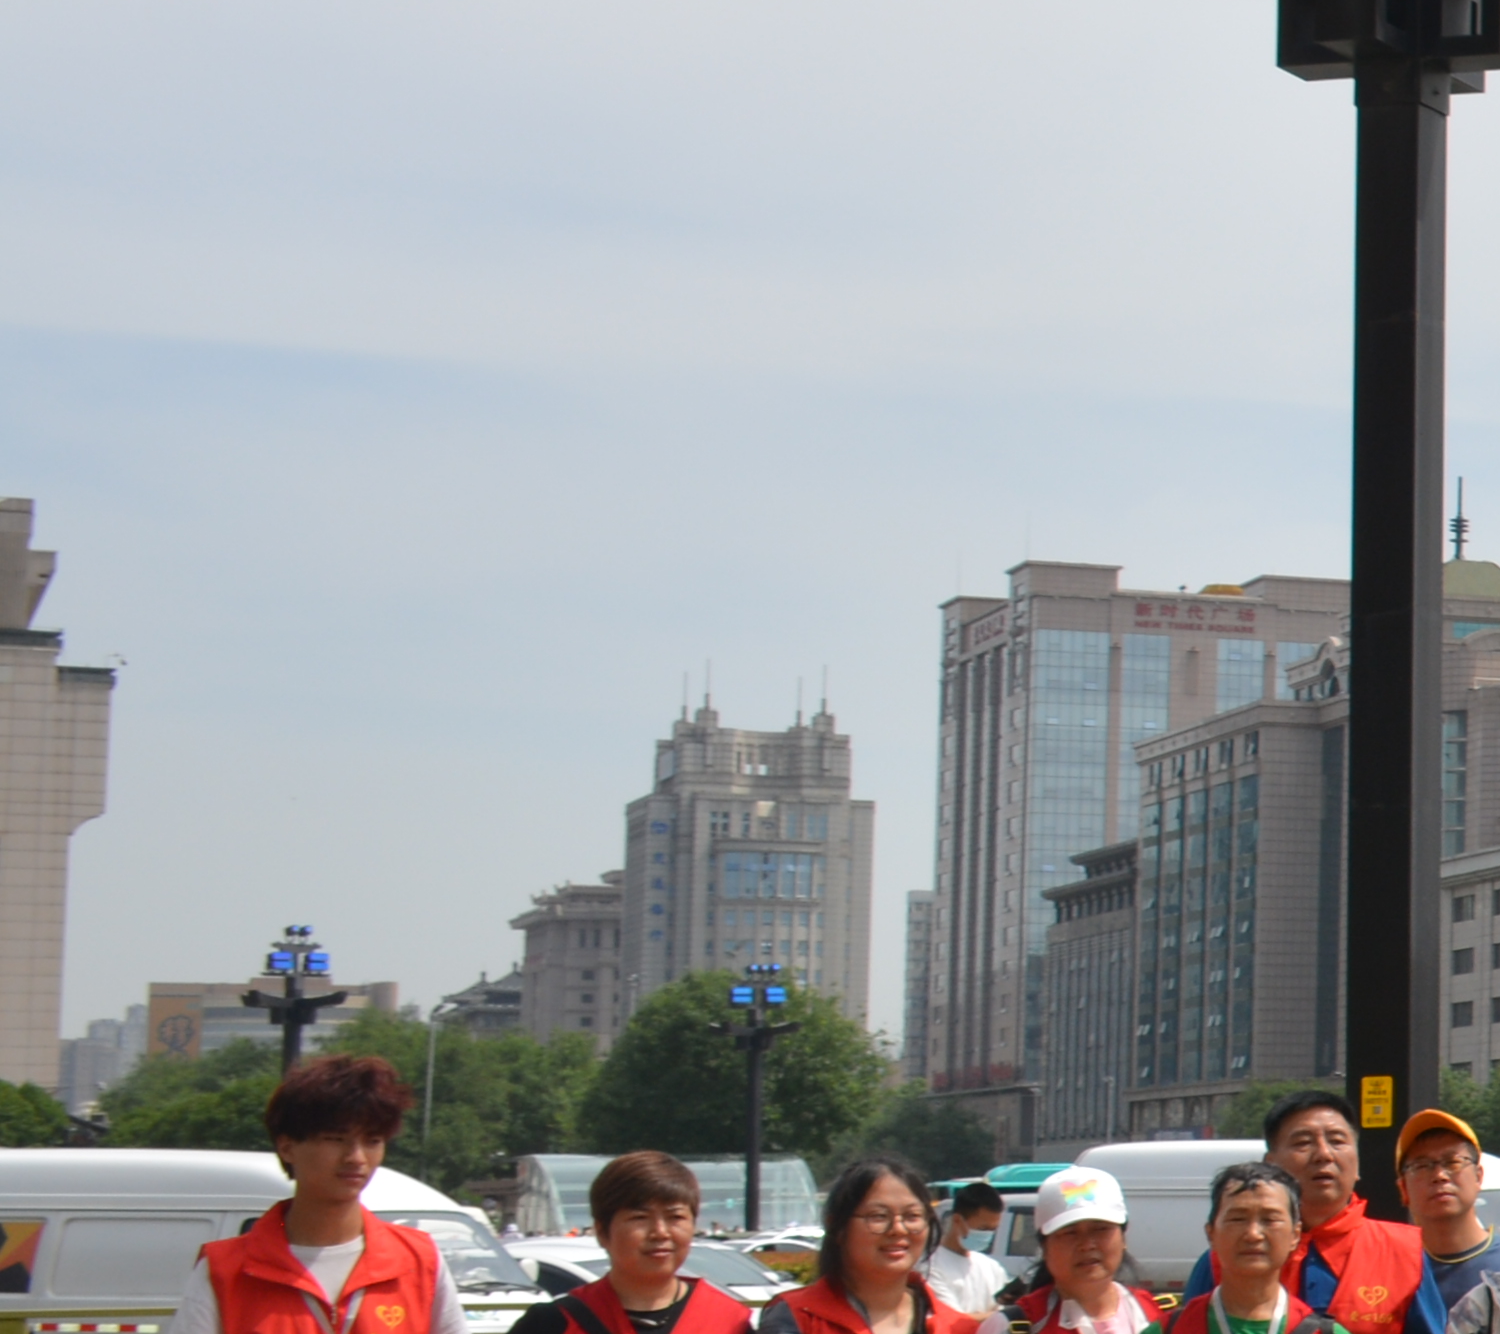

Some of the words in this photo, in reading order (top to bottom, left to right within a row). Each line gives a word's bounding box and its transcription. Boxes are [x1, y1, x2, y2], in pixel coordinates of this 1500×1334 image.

[1135, 603, 1257, 622] 新时代广场
[1135, 620, 1161, 629] NEW
[1169, 622, 1204, 631] TIMES
[1209, 624, 1256, 634] SQUARE
